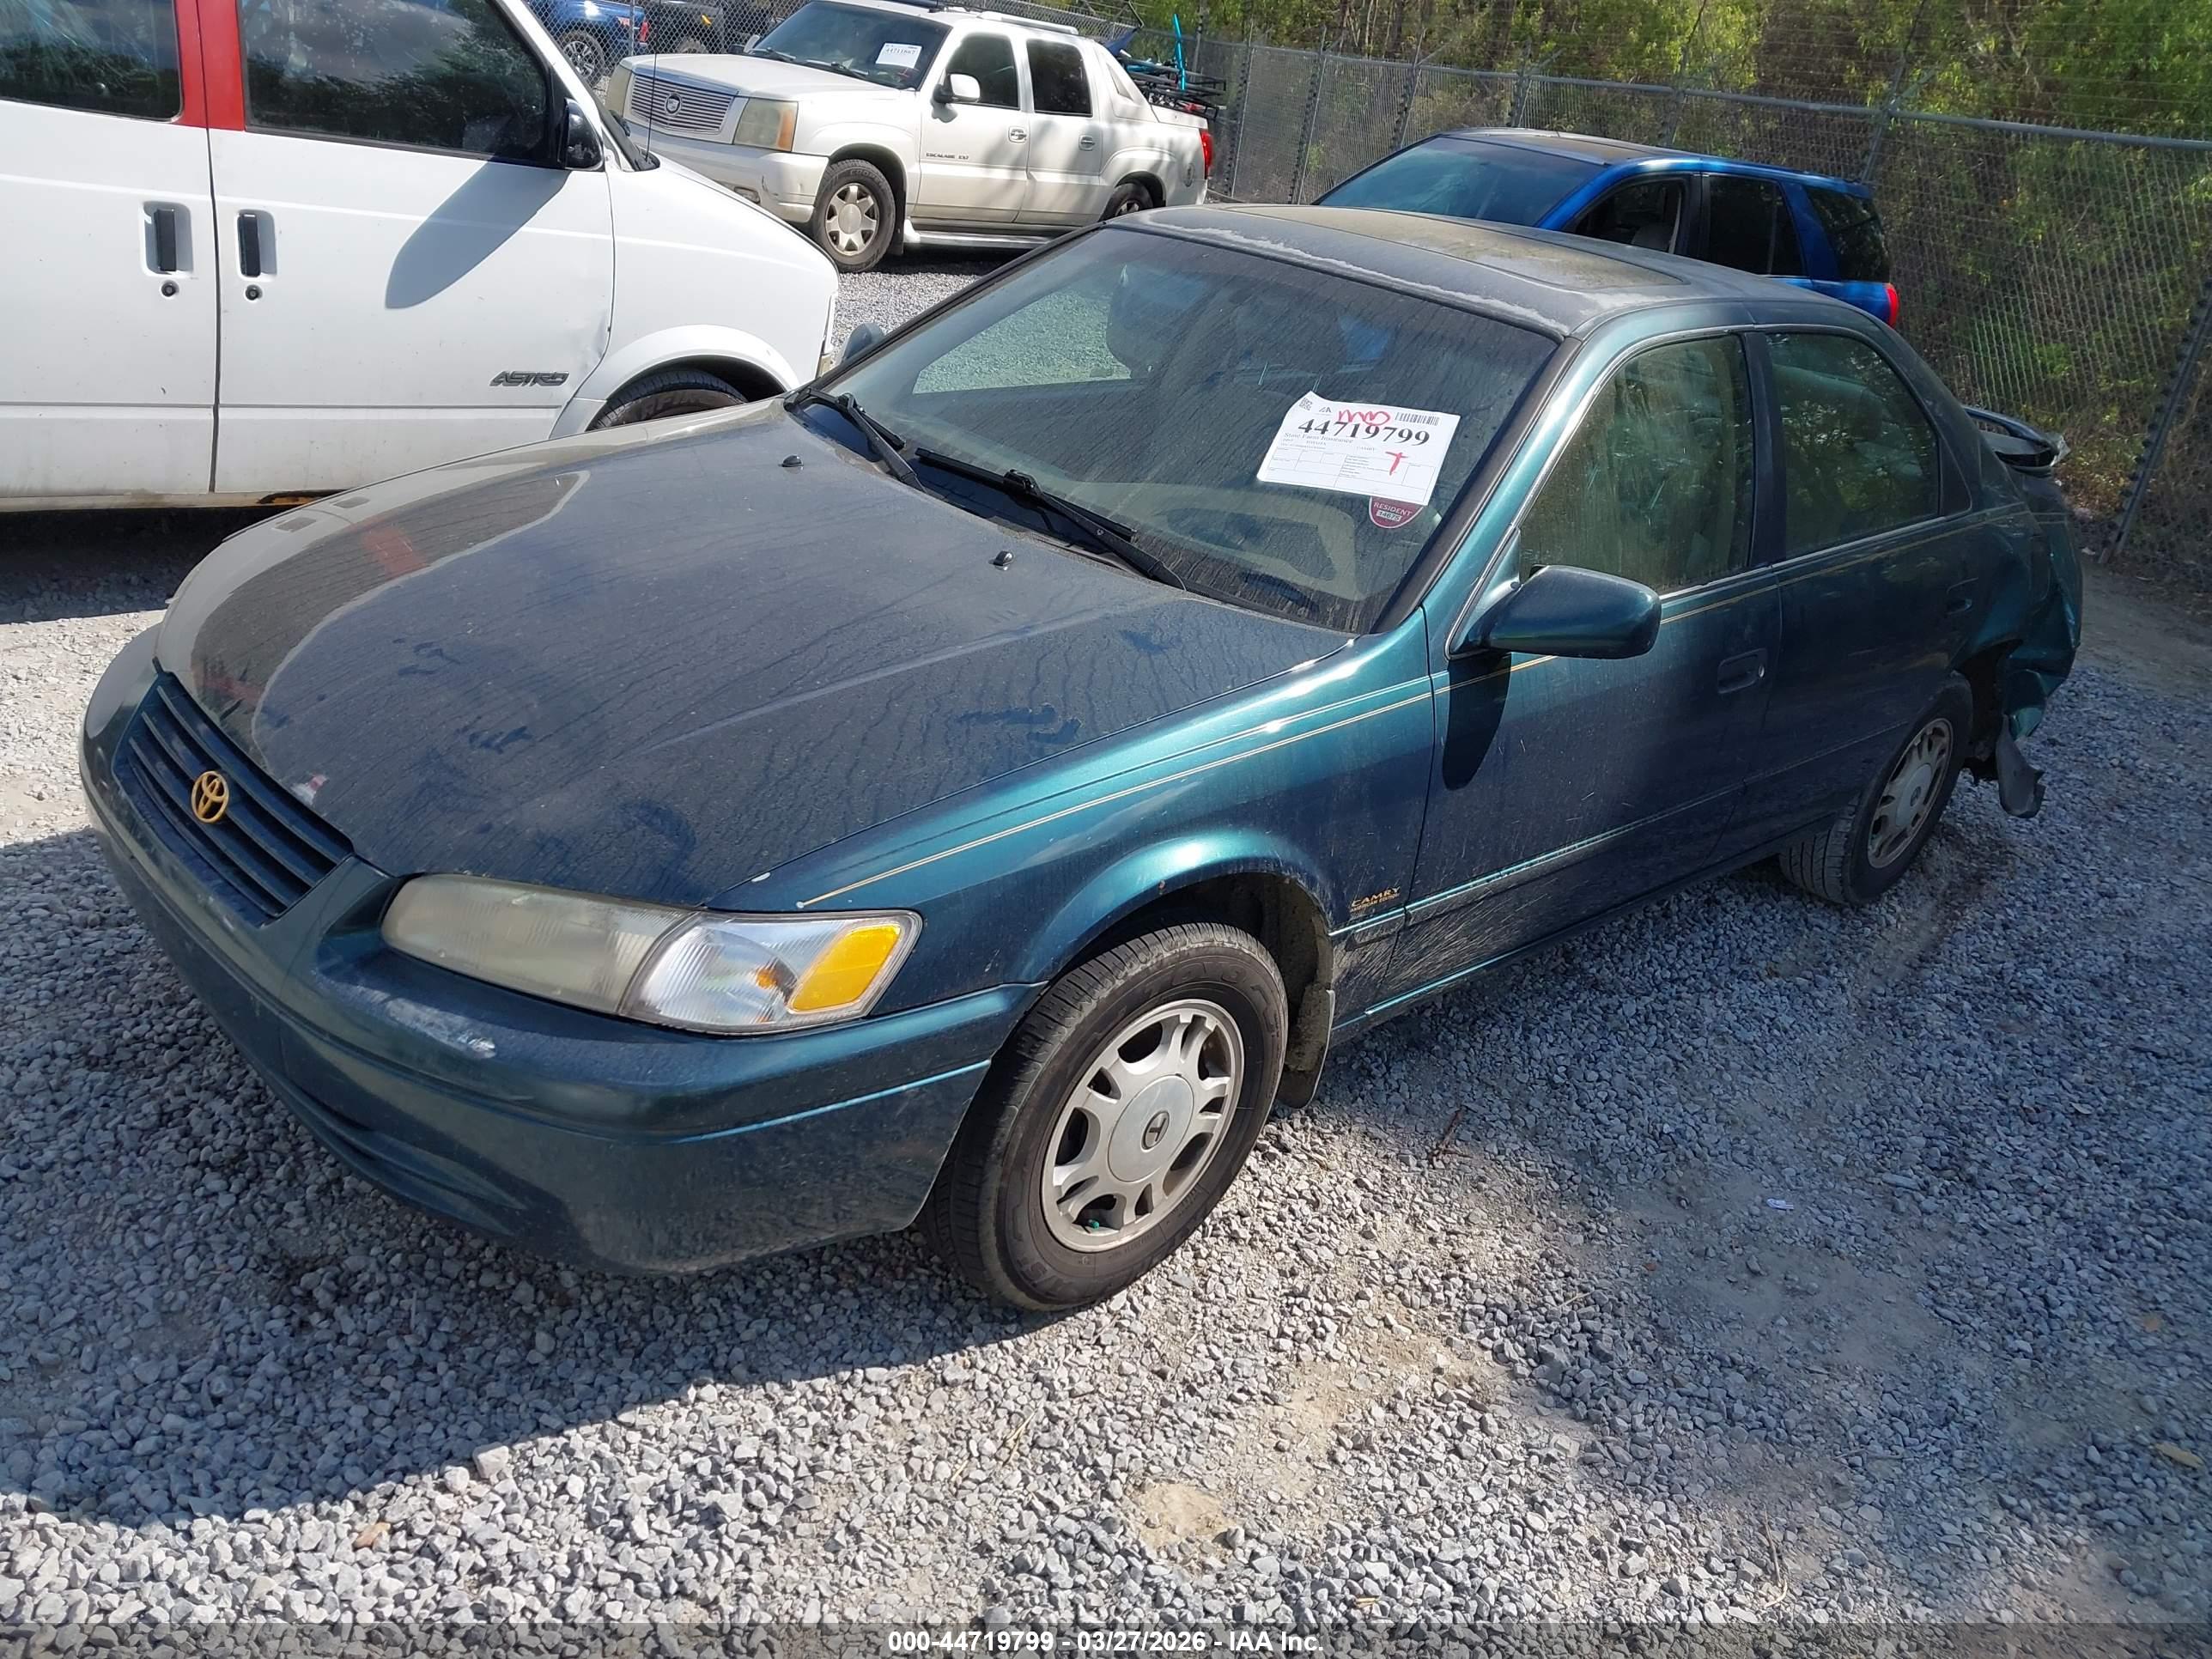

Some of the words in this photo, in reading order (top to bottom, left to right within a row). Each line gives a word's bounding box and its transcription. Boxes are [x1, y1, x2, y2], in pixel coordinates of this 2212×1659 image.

[489, 370, 569, 387] ASTRO
[1298, 419, 1430, 447] 44719799
[1373, 501, 1414, 517] RESIDENT
[1351, 886, 1401, 907] CAMRY
